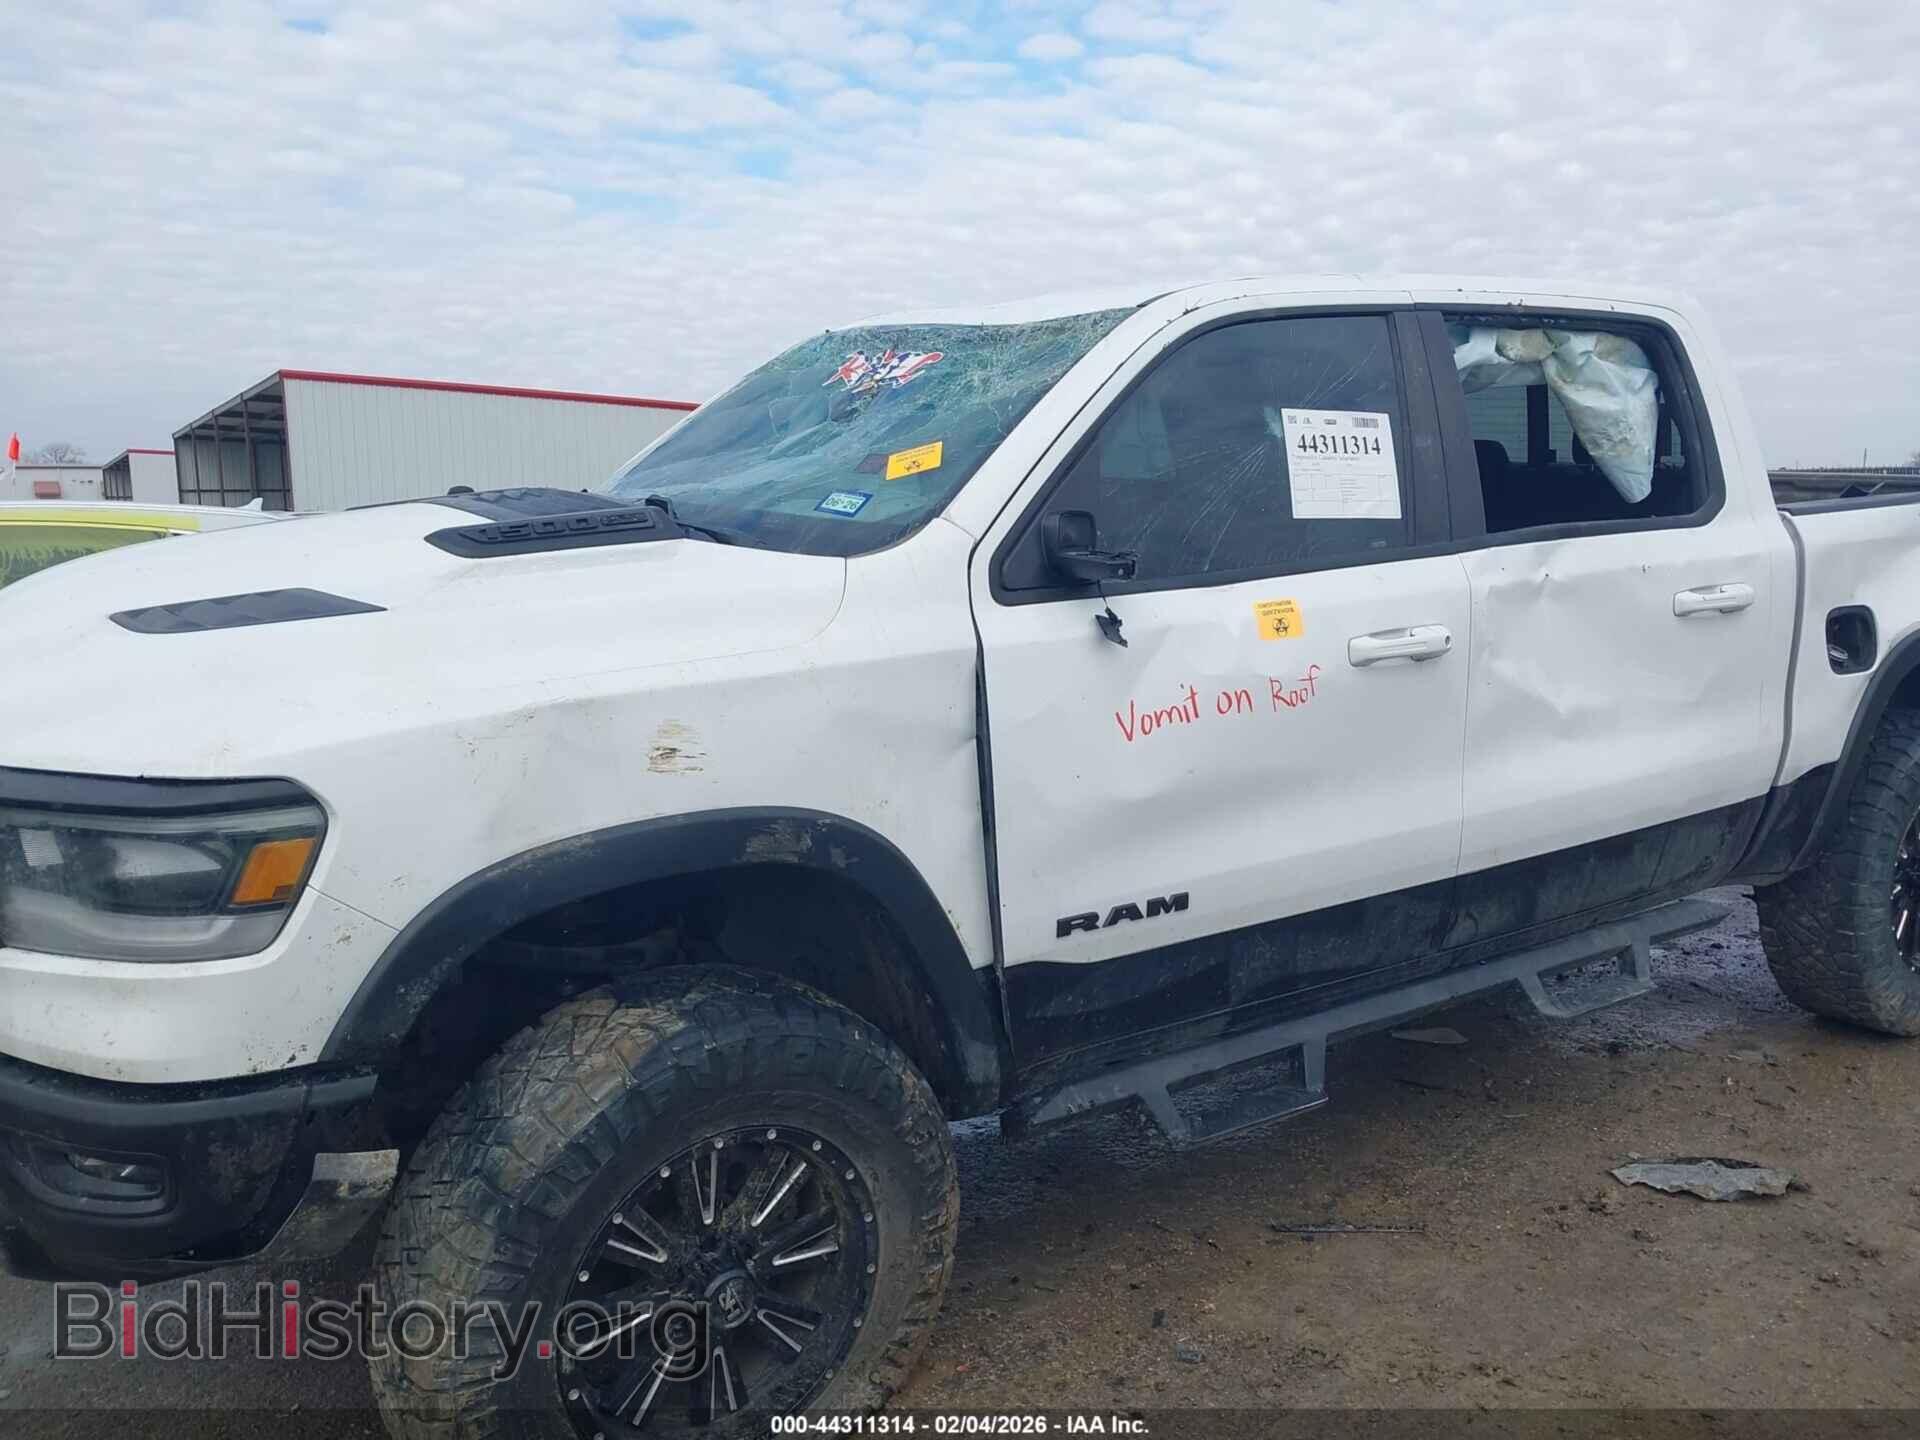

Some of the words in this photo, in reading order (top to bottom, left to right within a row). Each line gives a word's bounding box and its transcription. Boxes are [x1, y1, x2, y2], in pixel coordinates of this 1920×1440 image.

[1297, 433, 1381, 455] 44311314
[478, 516, 598, 541] 1500
[1115, 683, 1199, 741] Vomit
[1216, 688, 1253, 714] on
[1269, 664, 1321, 712] Roof
[1056, 892, 1189, 938] RAM
